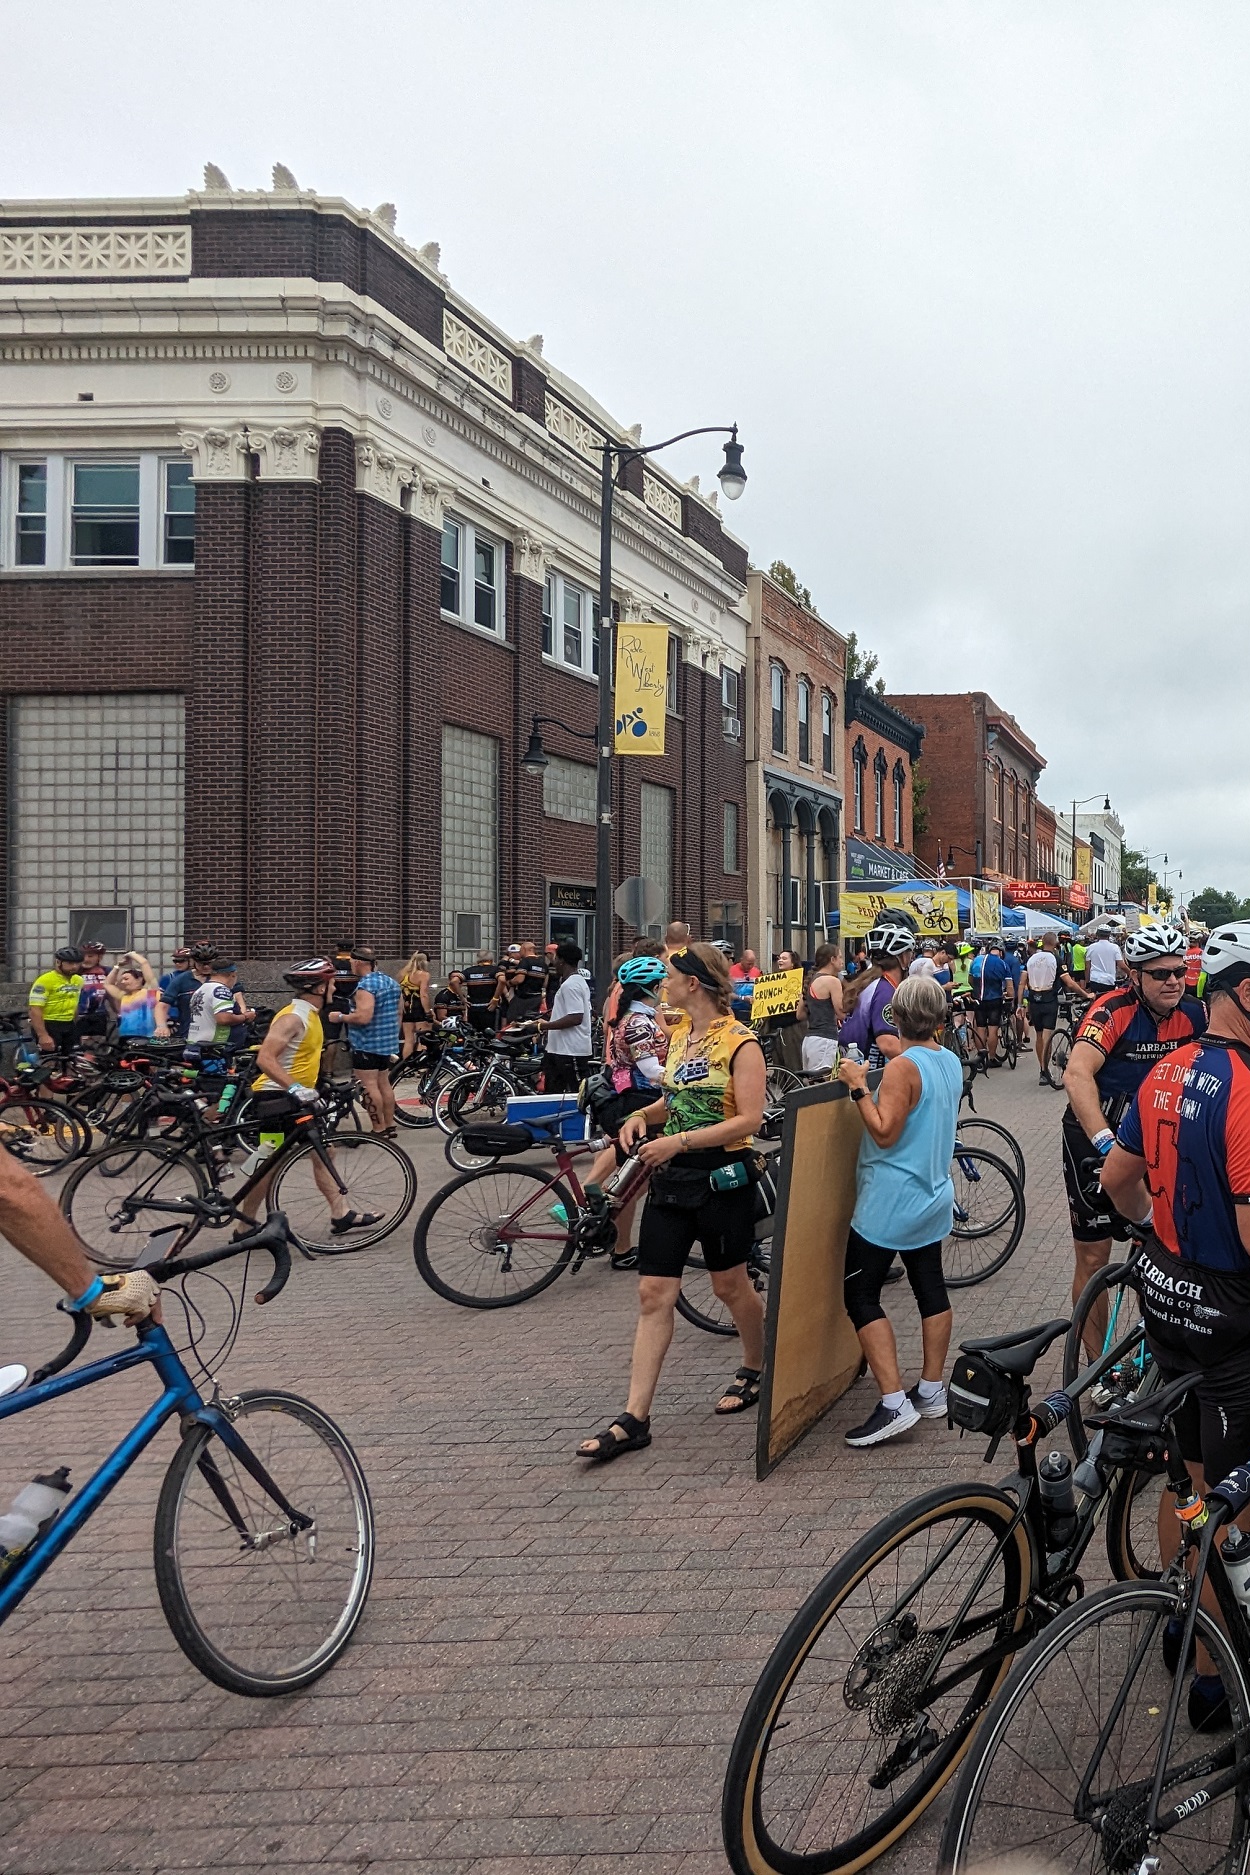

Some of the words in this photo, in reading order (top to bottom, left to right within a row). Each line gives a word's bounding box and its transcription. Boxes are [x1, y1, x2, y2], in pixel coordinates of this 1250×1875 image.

[625, 656, 655, 680] West
[635, 672, 665, 698] Liberty
[868, 863, 890, 879] MARKET
[557, 888, 580, 900] Keele
[1013, 890, 1050, 898] TRAND
[755, 973, 787, 984] BANANA
[755, 987, 783, 1000] CRUNCH
[1196, 1071, 1222, 1098] WITH
[1153, 1089, 1172, 1111] THE
[1169, 1314, 1181, 1325] in
[1183, 1317, 1213, 1335] Texas
